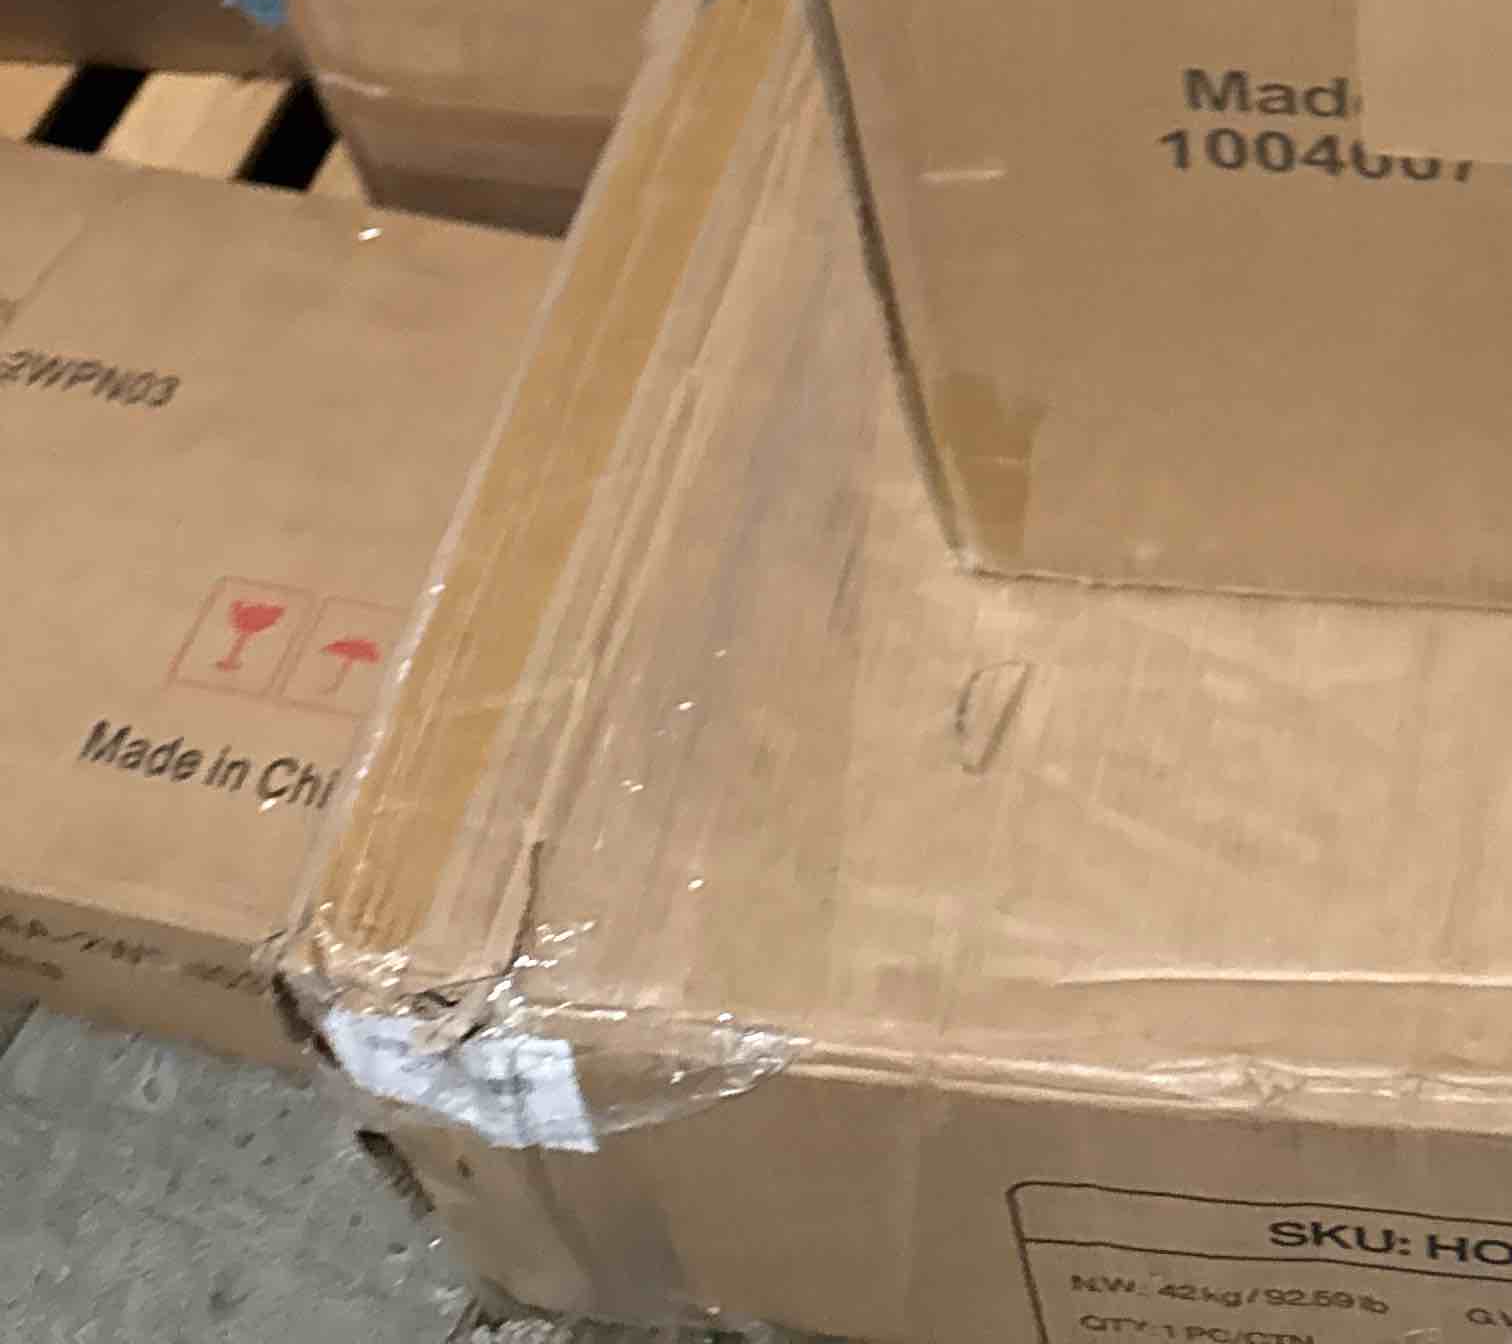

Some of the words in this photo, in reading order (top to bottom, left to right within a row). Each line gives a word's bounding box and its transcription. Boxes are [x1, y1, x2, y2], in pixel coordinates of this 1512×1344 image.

[1182, 67, 1362, 119] Mad
[78, 718, 205, 783] Made
[203, 743, 253, 793] in
[1268, 1221, 1412, 1255] SKU:
